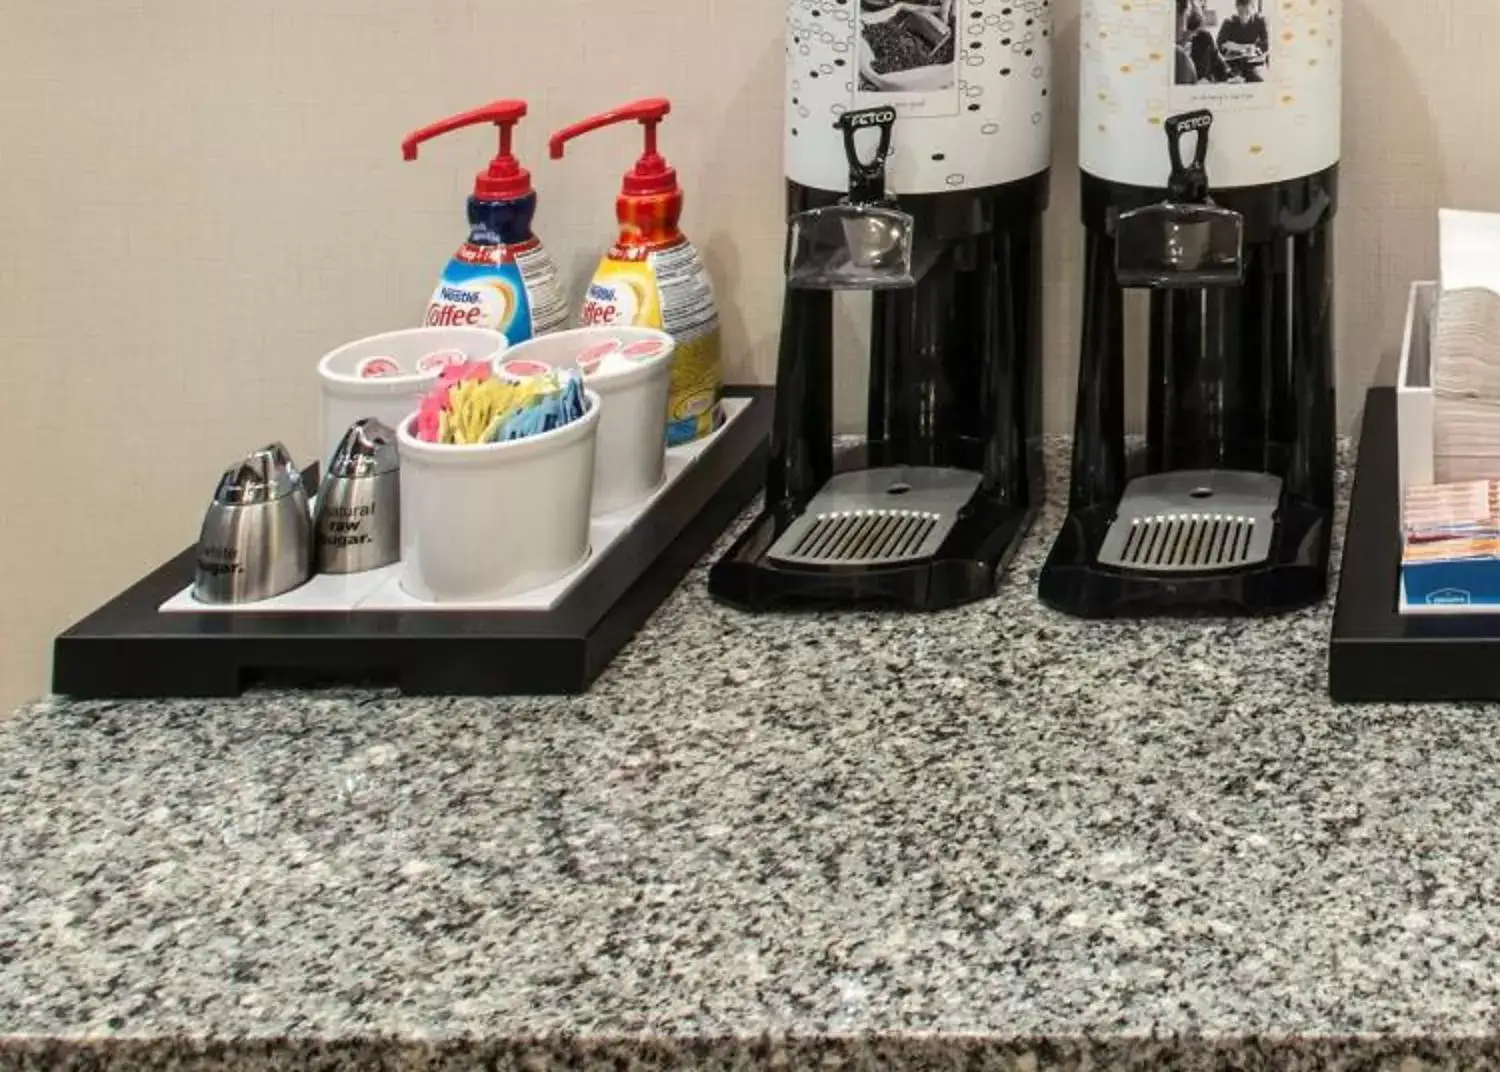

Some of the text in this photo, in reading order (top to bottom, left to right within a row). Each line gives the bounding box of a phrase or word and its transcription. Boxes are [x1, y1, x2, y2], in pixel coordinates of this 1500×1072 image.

[851, 111, 893, 126] FETCO
[1178, 115, 1211, 131] FETCO
[330, 521, 360, 532] raw
[198, 560, 244, 576] ugar.
